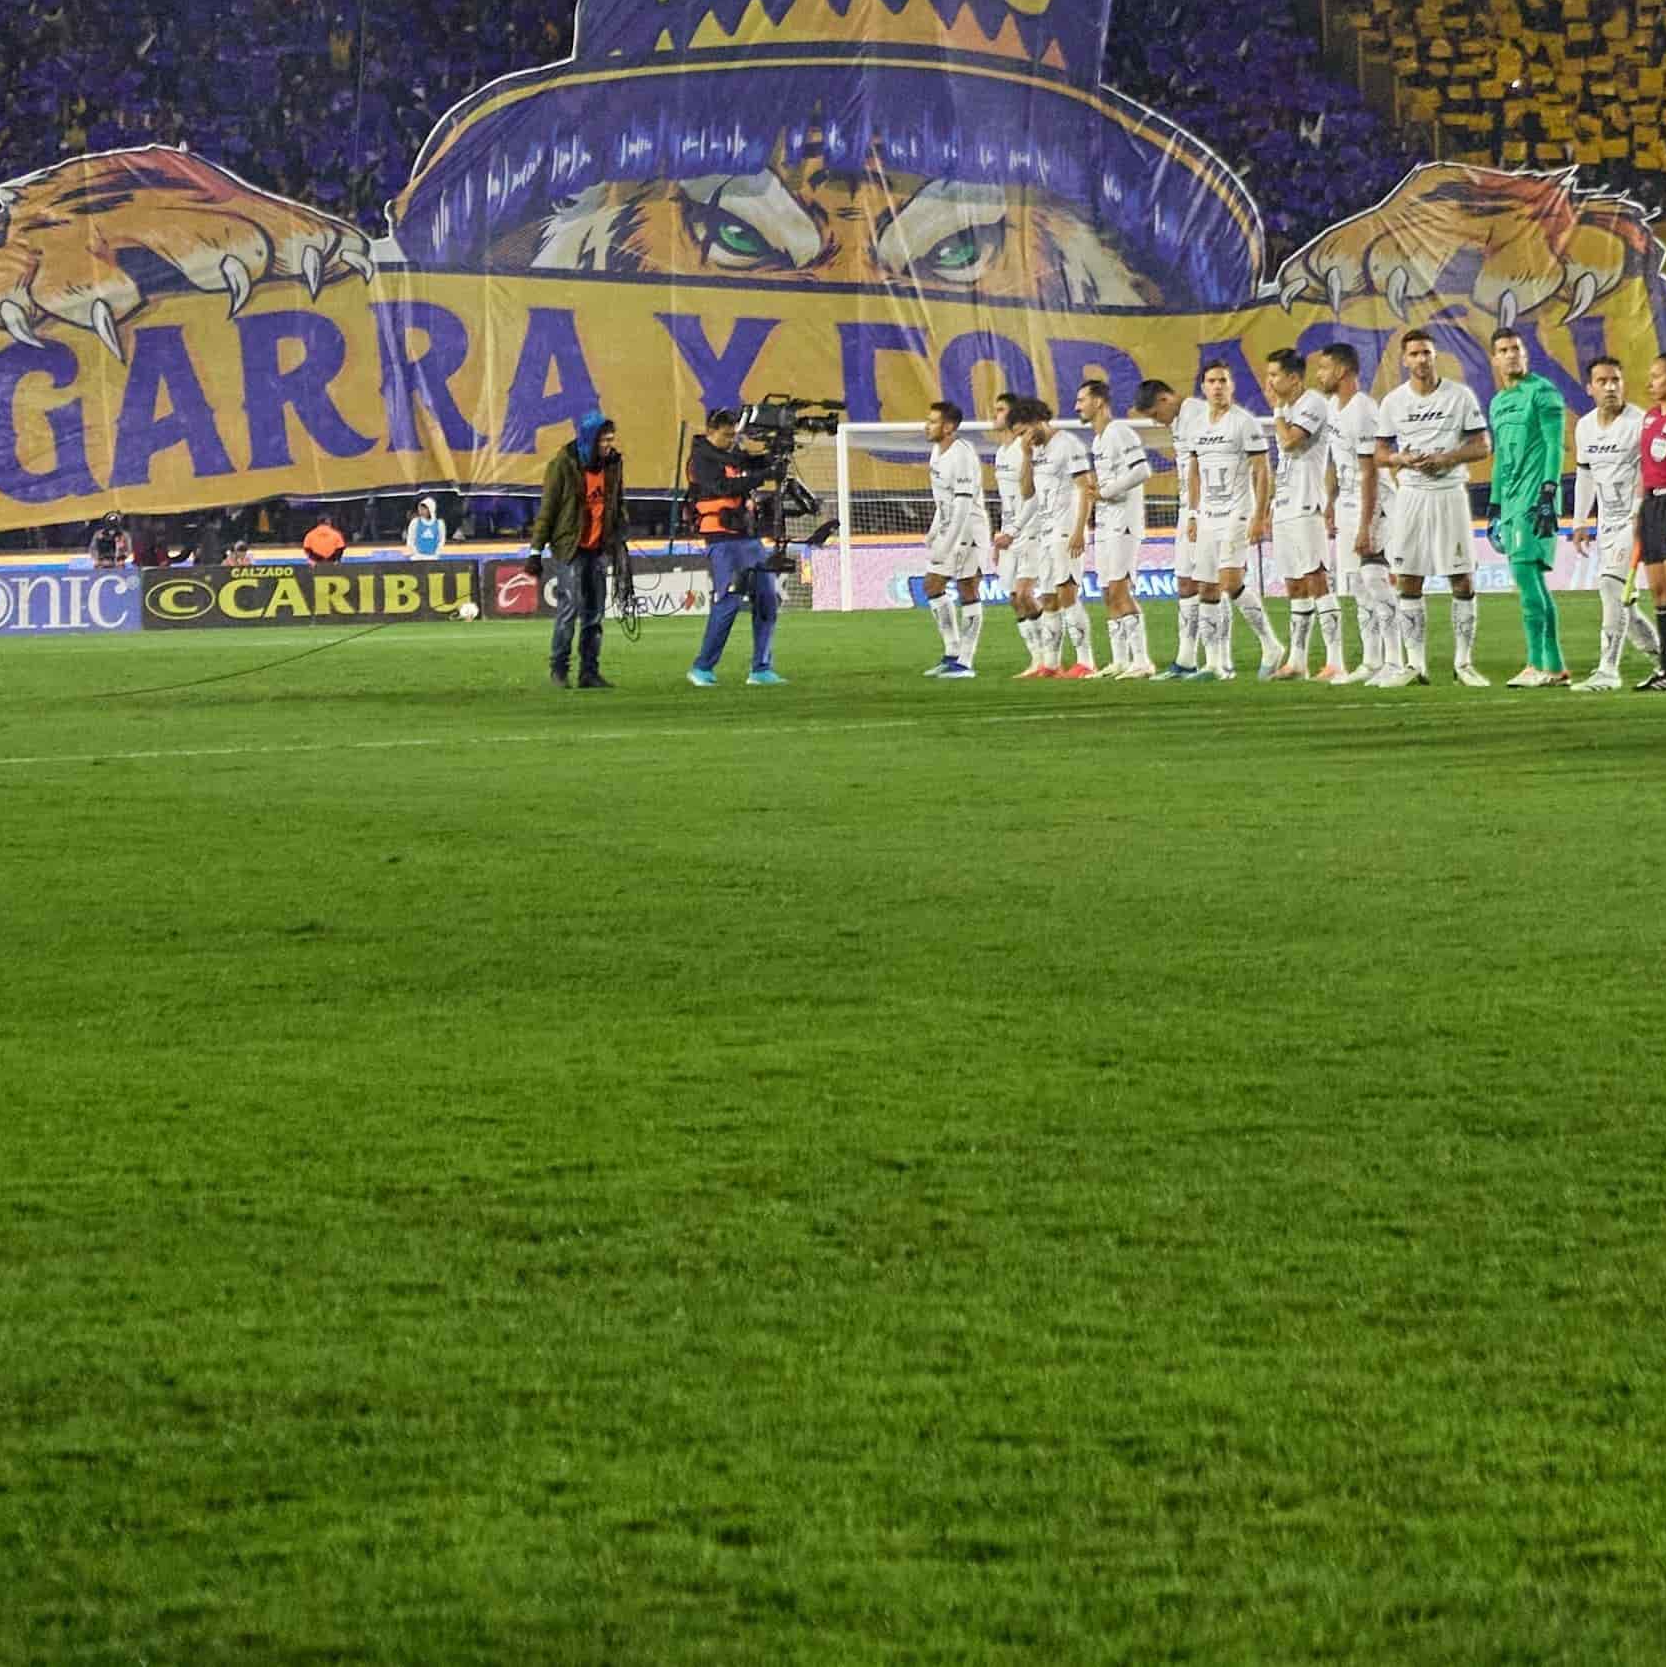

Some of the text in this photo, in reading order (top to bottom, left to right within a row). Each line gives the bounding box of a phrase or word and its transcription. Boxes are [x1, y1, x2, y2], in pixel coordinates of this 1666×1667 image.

[654, 313, 781, 412] Y
[217, 572, 474, 619] CARIBU
[231, 566, 294, 579] CALZADO
